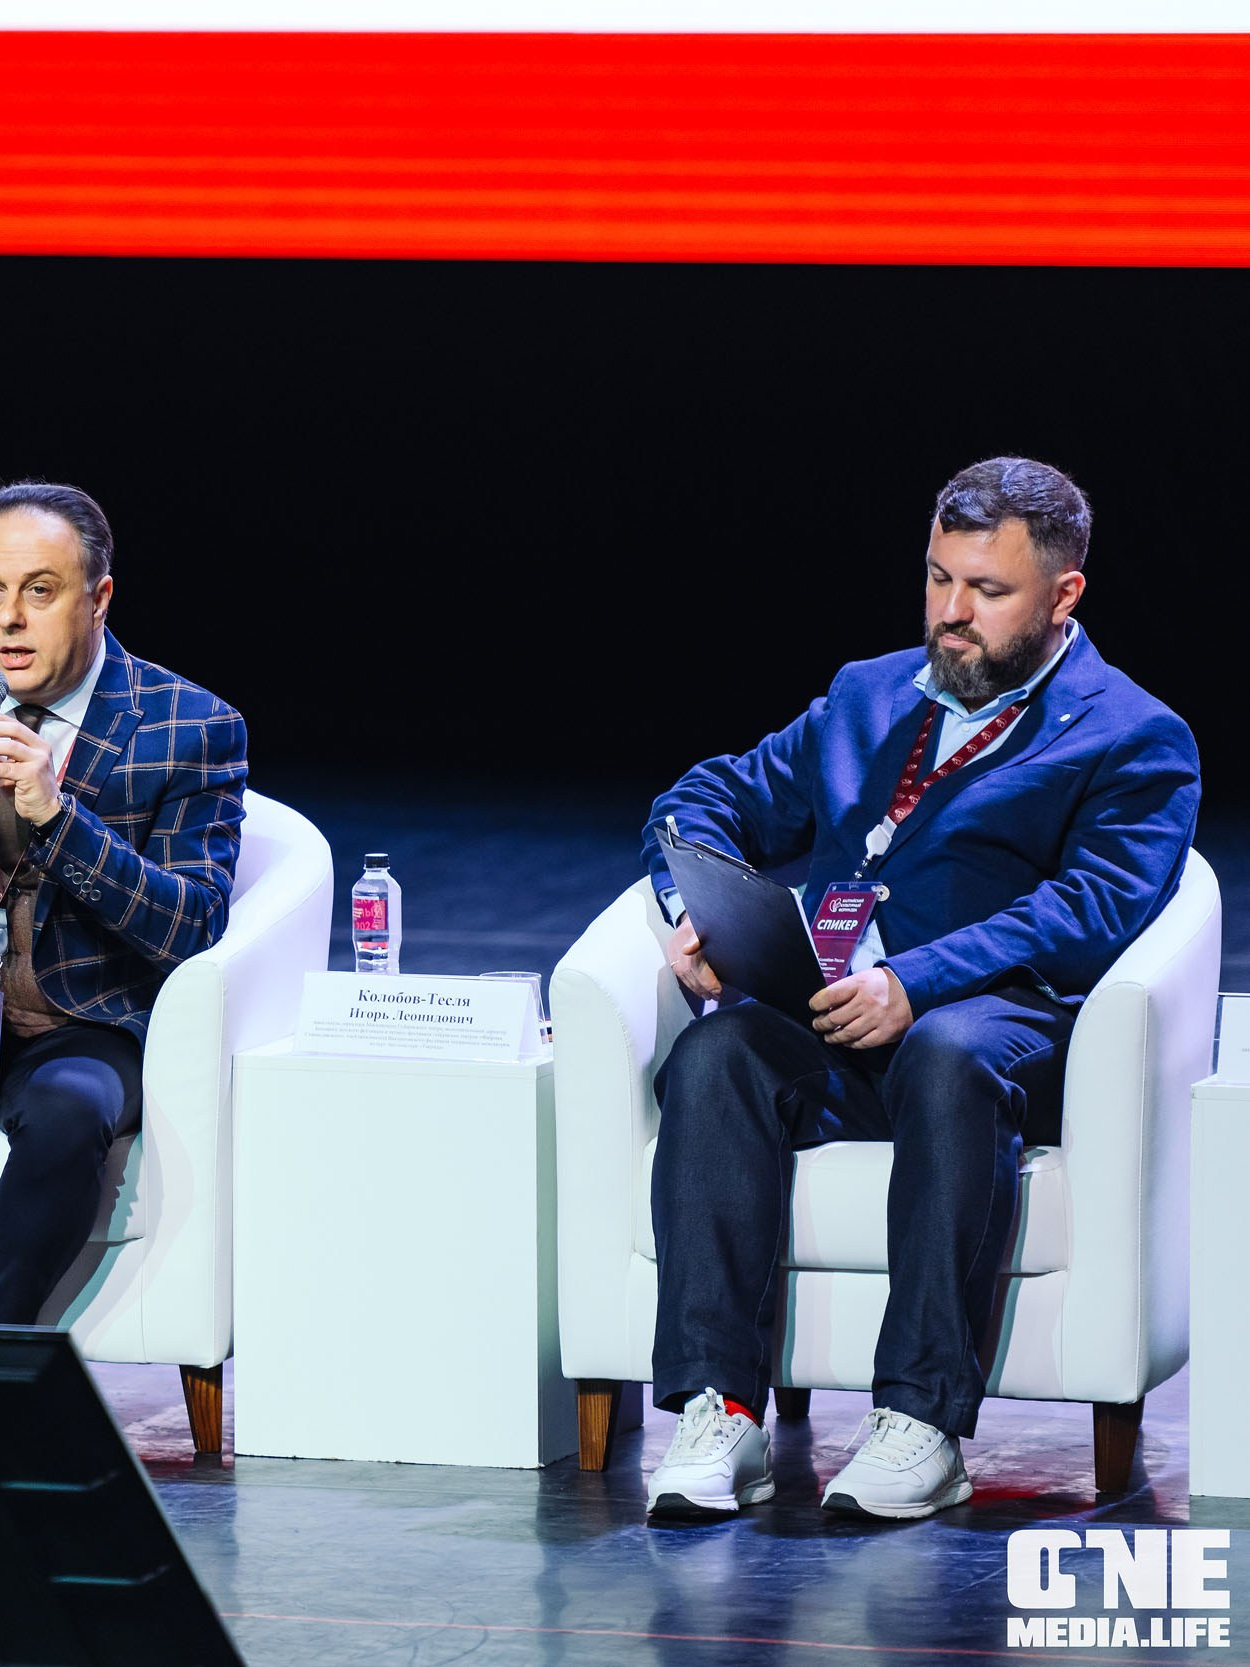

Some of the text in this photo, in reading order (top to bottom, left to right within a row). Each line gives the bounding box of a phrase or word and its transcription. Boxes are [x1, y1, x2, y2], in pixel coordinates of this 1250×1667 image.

[816, 919, 859, 931] СПИКЕР
[358, 989, 471, 1007] Колобов-Тесля
[349, 1007, 474, 1025] Игорь Леонидович
